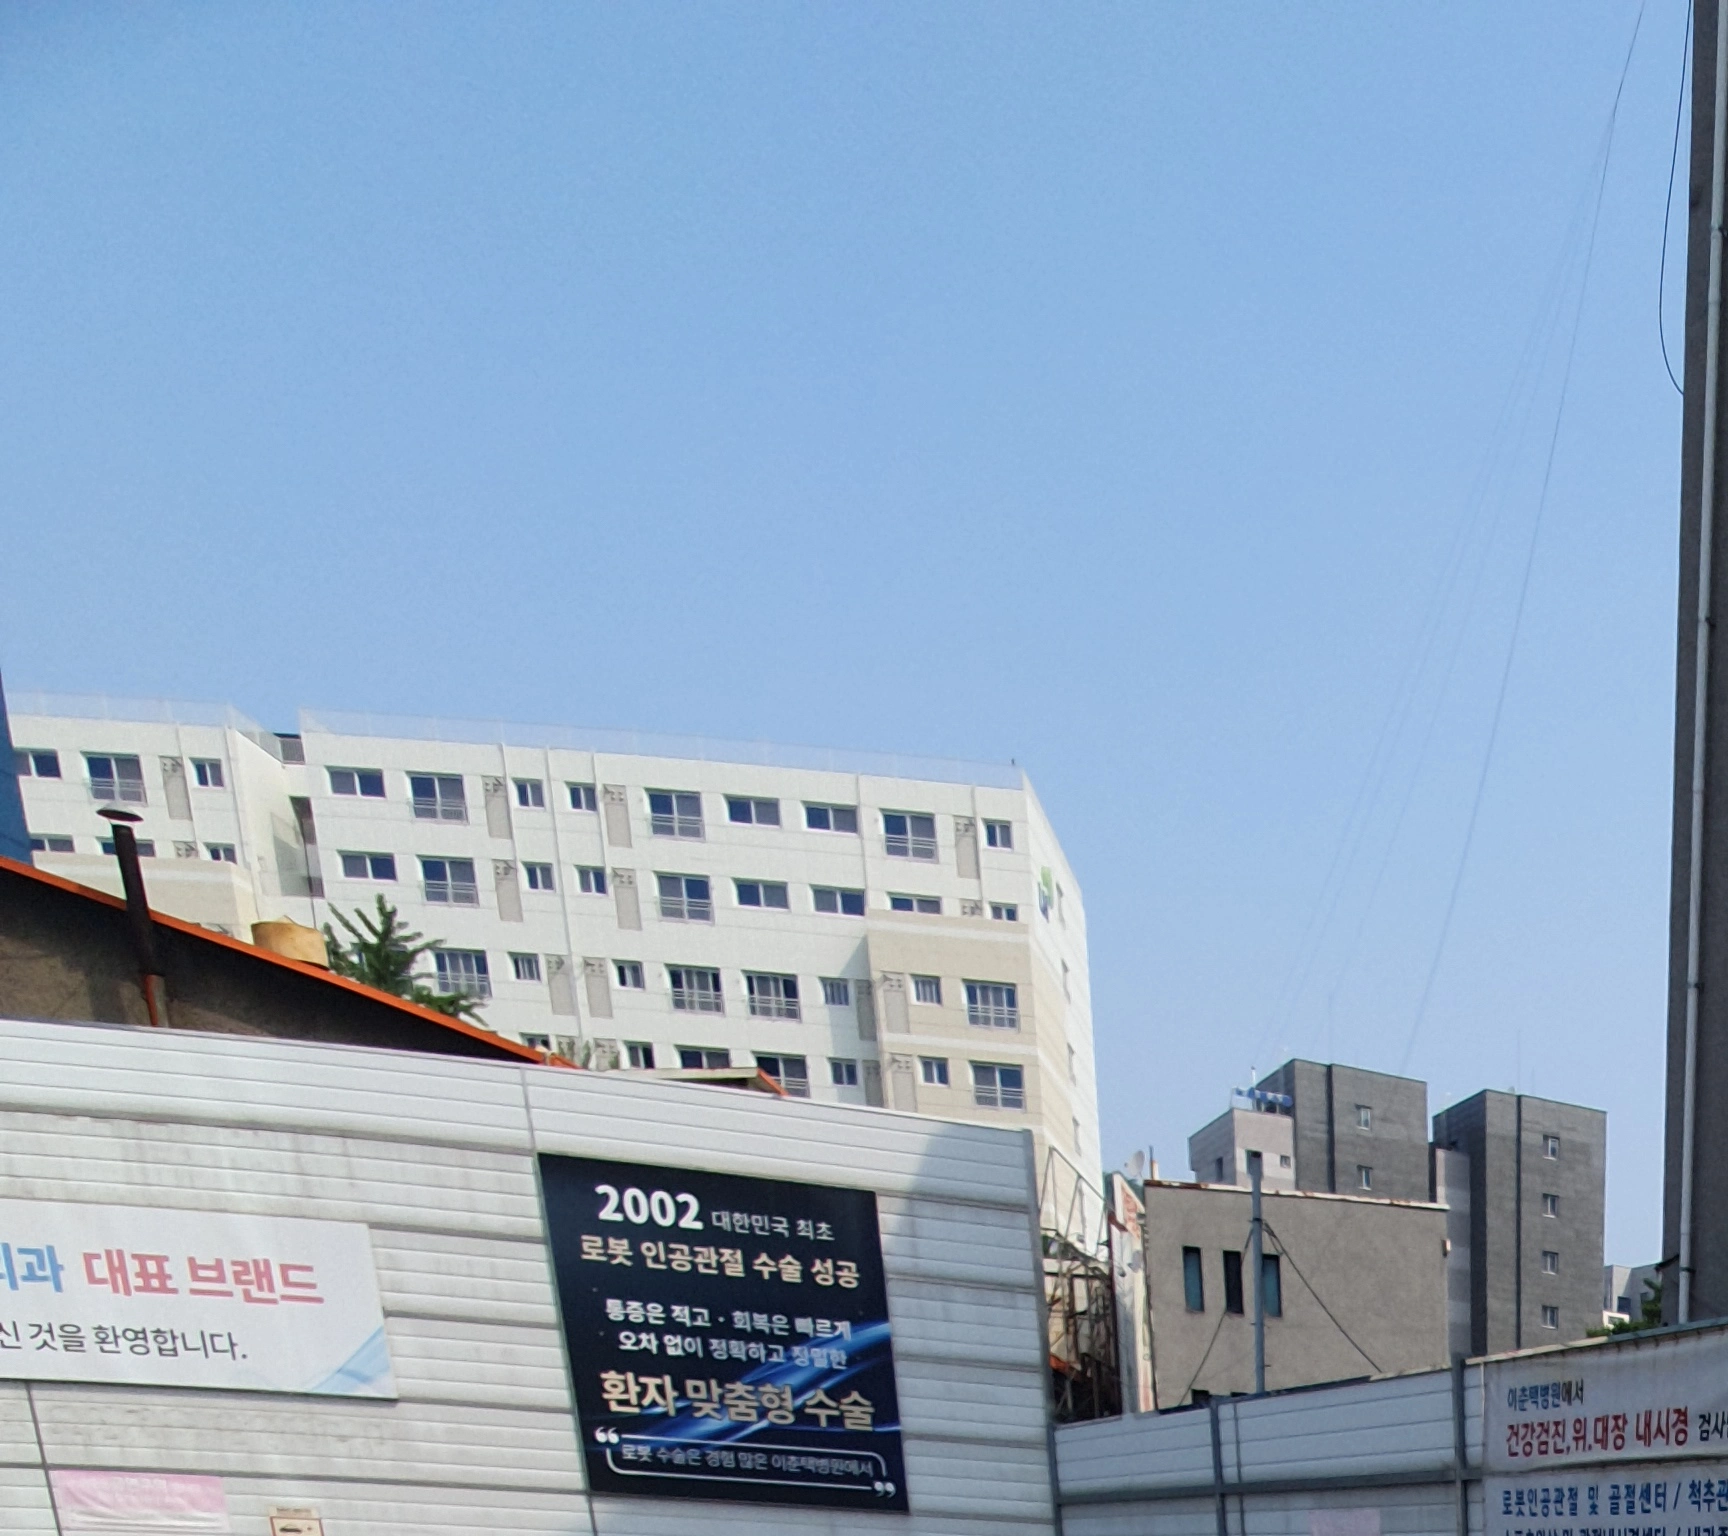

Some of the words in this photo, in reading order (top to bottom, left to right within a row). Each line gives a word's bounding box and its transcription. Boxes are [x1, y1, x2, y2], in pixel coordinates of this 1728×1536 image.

[595, 1184, 704, 1230] 2002
[711, 1210, 790, 1238] 대한민국
[795, 1218, 836, 1242] 최초
[82, 1248, 179, 1297] 대표
[187, 1256, 324, 1305] 브랜드
[580, 1234, 633, 1267] 로봇
[640, 1241, 745, 1278] 인공관절
[752, 1252, 803, 1283] 수술
[810, 1257, 860, 1289] 성공
[28, 1322, 87, 1353] 것을
[92, 1324, 248, 1360] 환영합니다.
[605, 1298, 666, 1325] 통증은
[670, 1304, 712, 1328] 적고
[732, 1310, 790, 1336] 회복은
[794, 1317, 851, 1342] 빠르게
[618, 1331, 659, 1355] 오차
[663, 1333, 703, 1358] 없이
[708, 1337, 786, 1364] 정확하고
[792, 1346, 847, 1370] 정밀한
[600, 1369, 679, 1417] 환자
[685, 1378, 796, 1426] 맞춤형
[804, 1388, 875, 1432] 수술
[1507, 1379, 1584, 1411] 이춘택병원에서
[1635, 1405, 1689, 1447] 내시경
[621, 1444, 652, 1462] 로봇
[657, 1447, 701, 1466] 수술은
[705, 1450, 736, 1468] 경험
[738, 1452, 768, 1471] 많은
[1502, 1486, 1578, 1517] 로봇인공관절
[1587, 1484, 1600, 1515] 및
[1609, 1481, 1667, 1515] 골절센터
